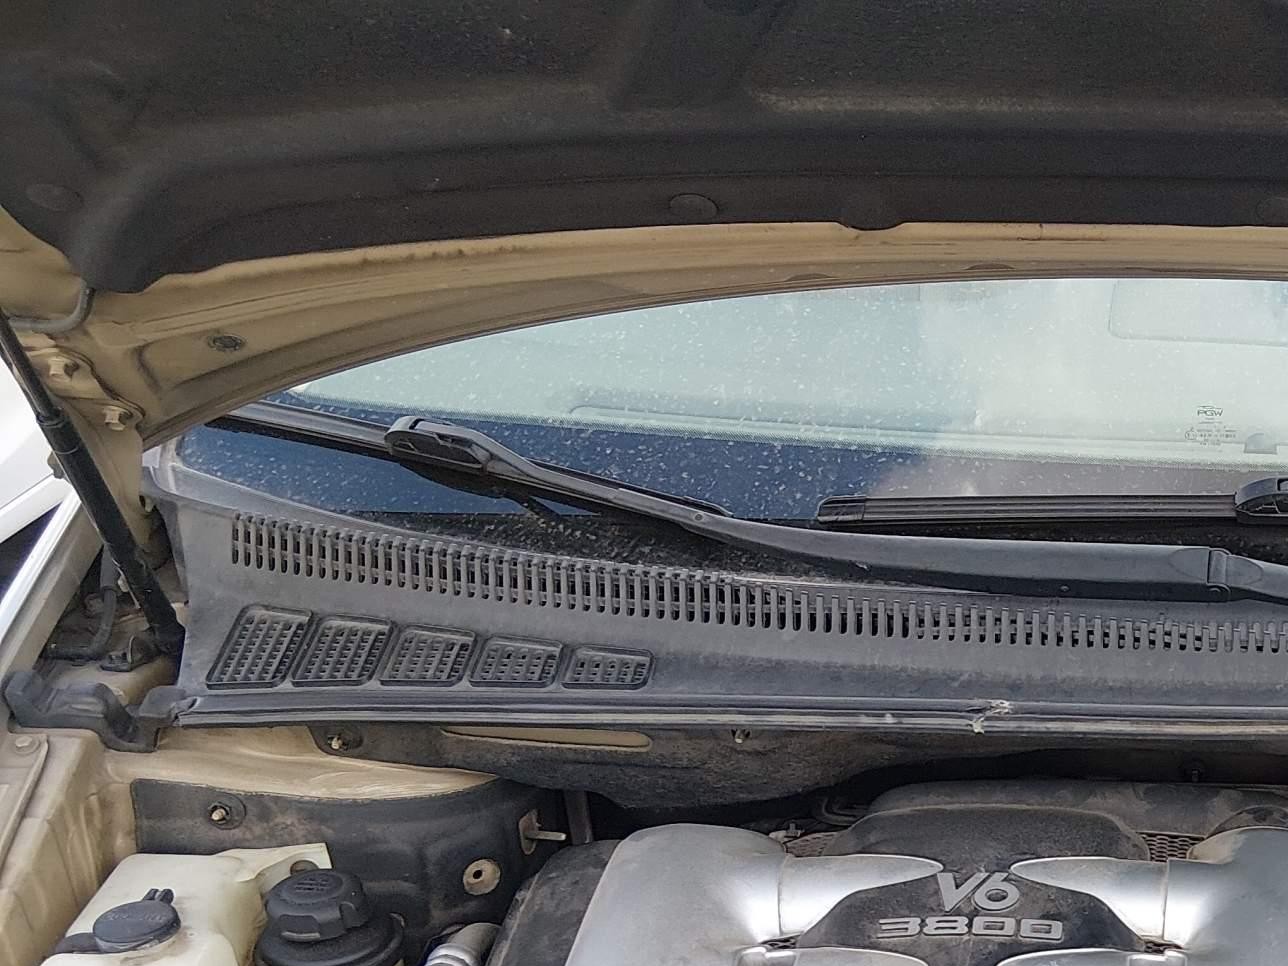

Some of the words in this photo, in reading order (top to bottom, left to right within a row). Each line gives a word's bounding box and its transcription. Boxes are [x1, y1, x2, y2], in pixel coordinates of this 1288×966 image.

[1197, 408, 1223, 416] PGW
[937, 872, 1020, 912] V6
[876, 915, 1064, 941] 3800
